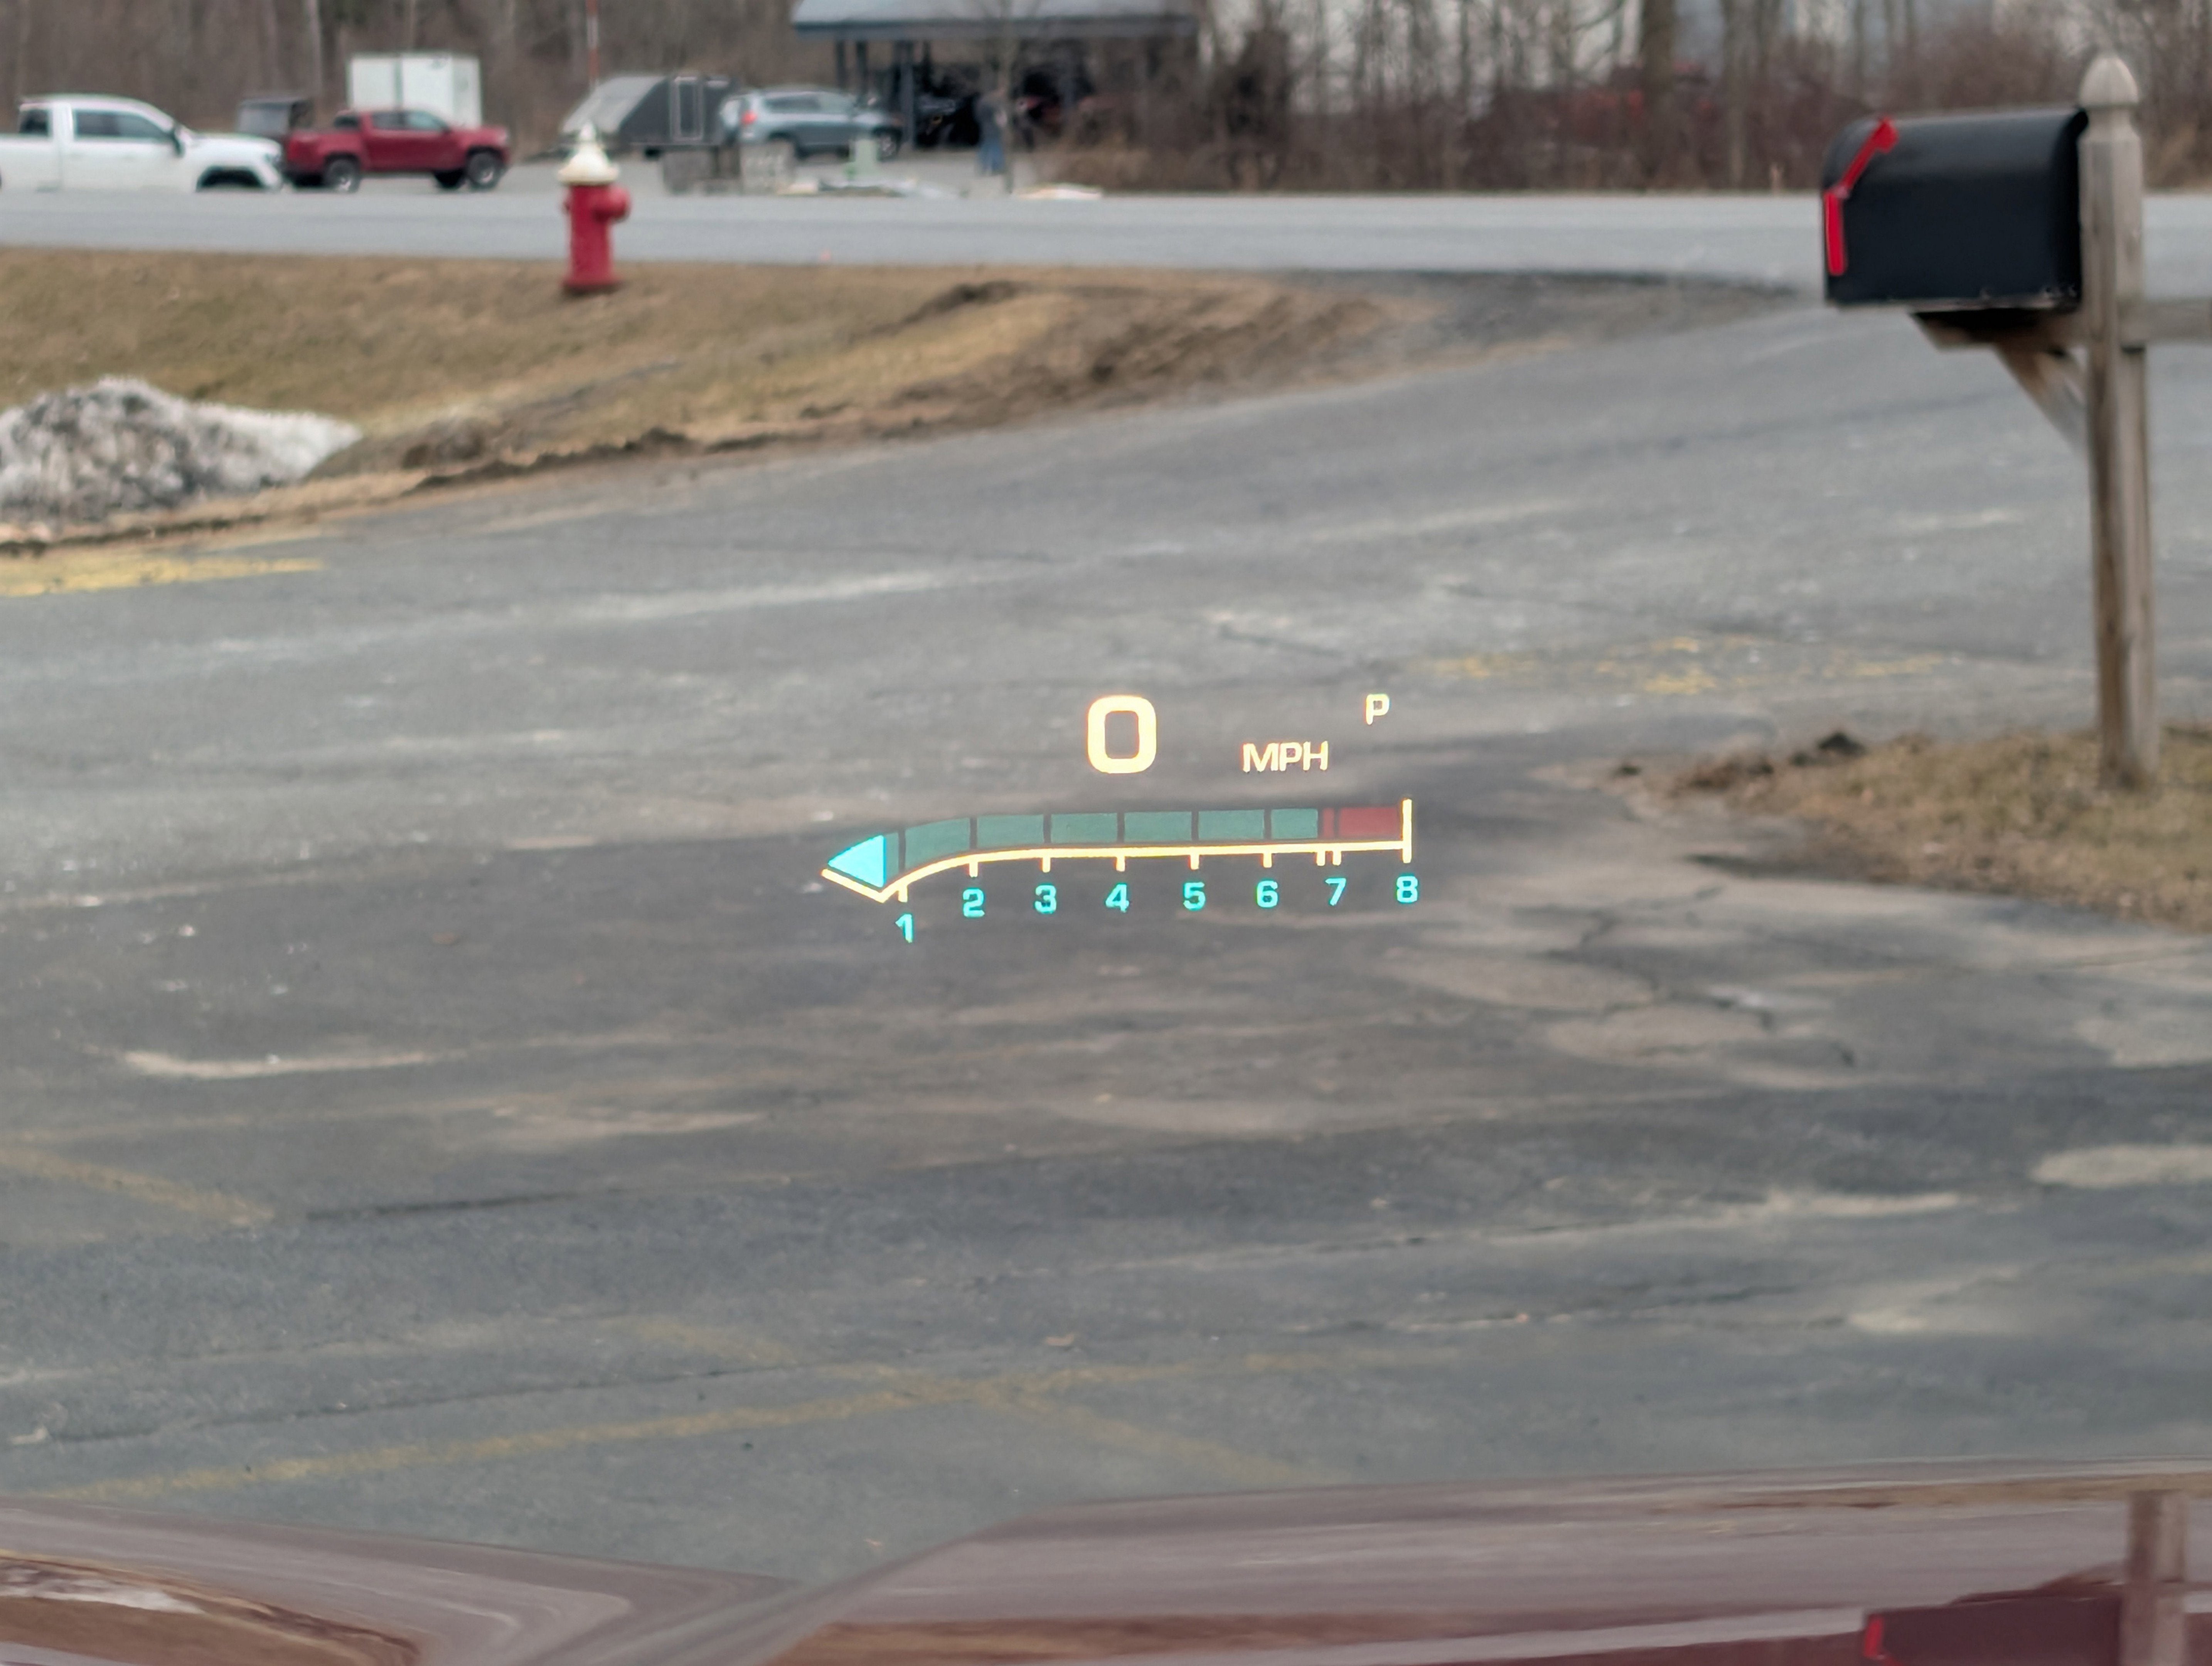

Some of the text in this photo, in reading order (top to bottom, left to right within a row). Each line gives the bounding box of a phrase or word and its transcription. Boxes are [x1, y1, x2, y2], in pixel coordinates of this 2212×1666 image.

[1087, 694, 1328, 774] 0 MPH
[1365, 693, 1390, 725] P
[895, 873, 1419, 943] 1 2 3 4 5 6 7 8
